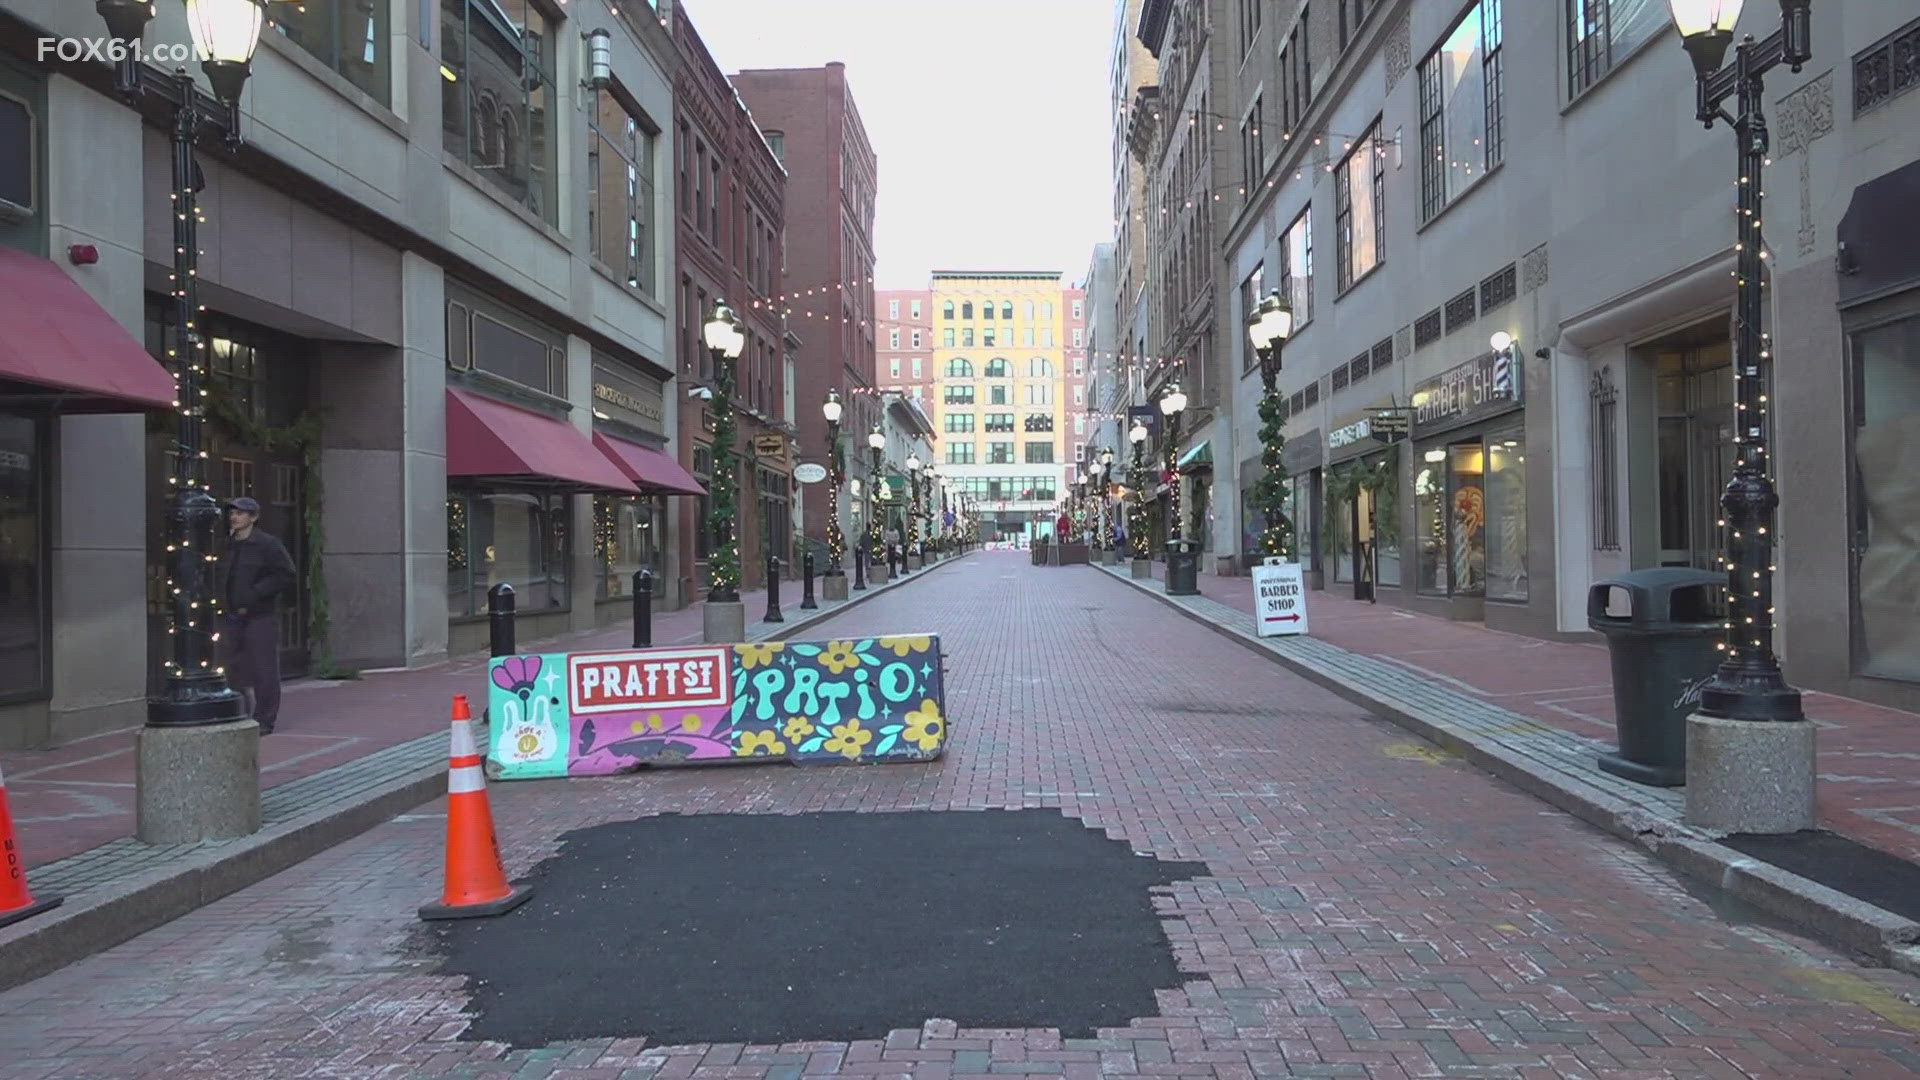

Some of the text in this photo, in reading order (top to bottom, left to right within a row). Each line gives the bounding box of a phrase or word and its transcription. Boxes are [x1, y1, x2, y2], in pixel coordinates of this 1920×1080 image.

[1260, 584, 1299, 598] BARBER
[1267, 598, 1295, 612] SHOP
[582, 662, 680, 699] PRATT
